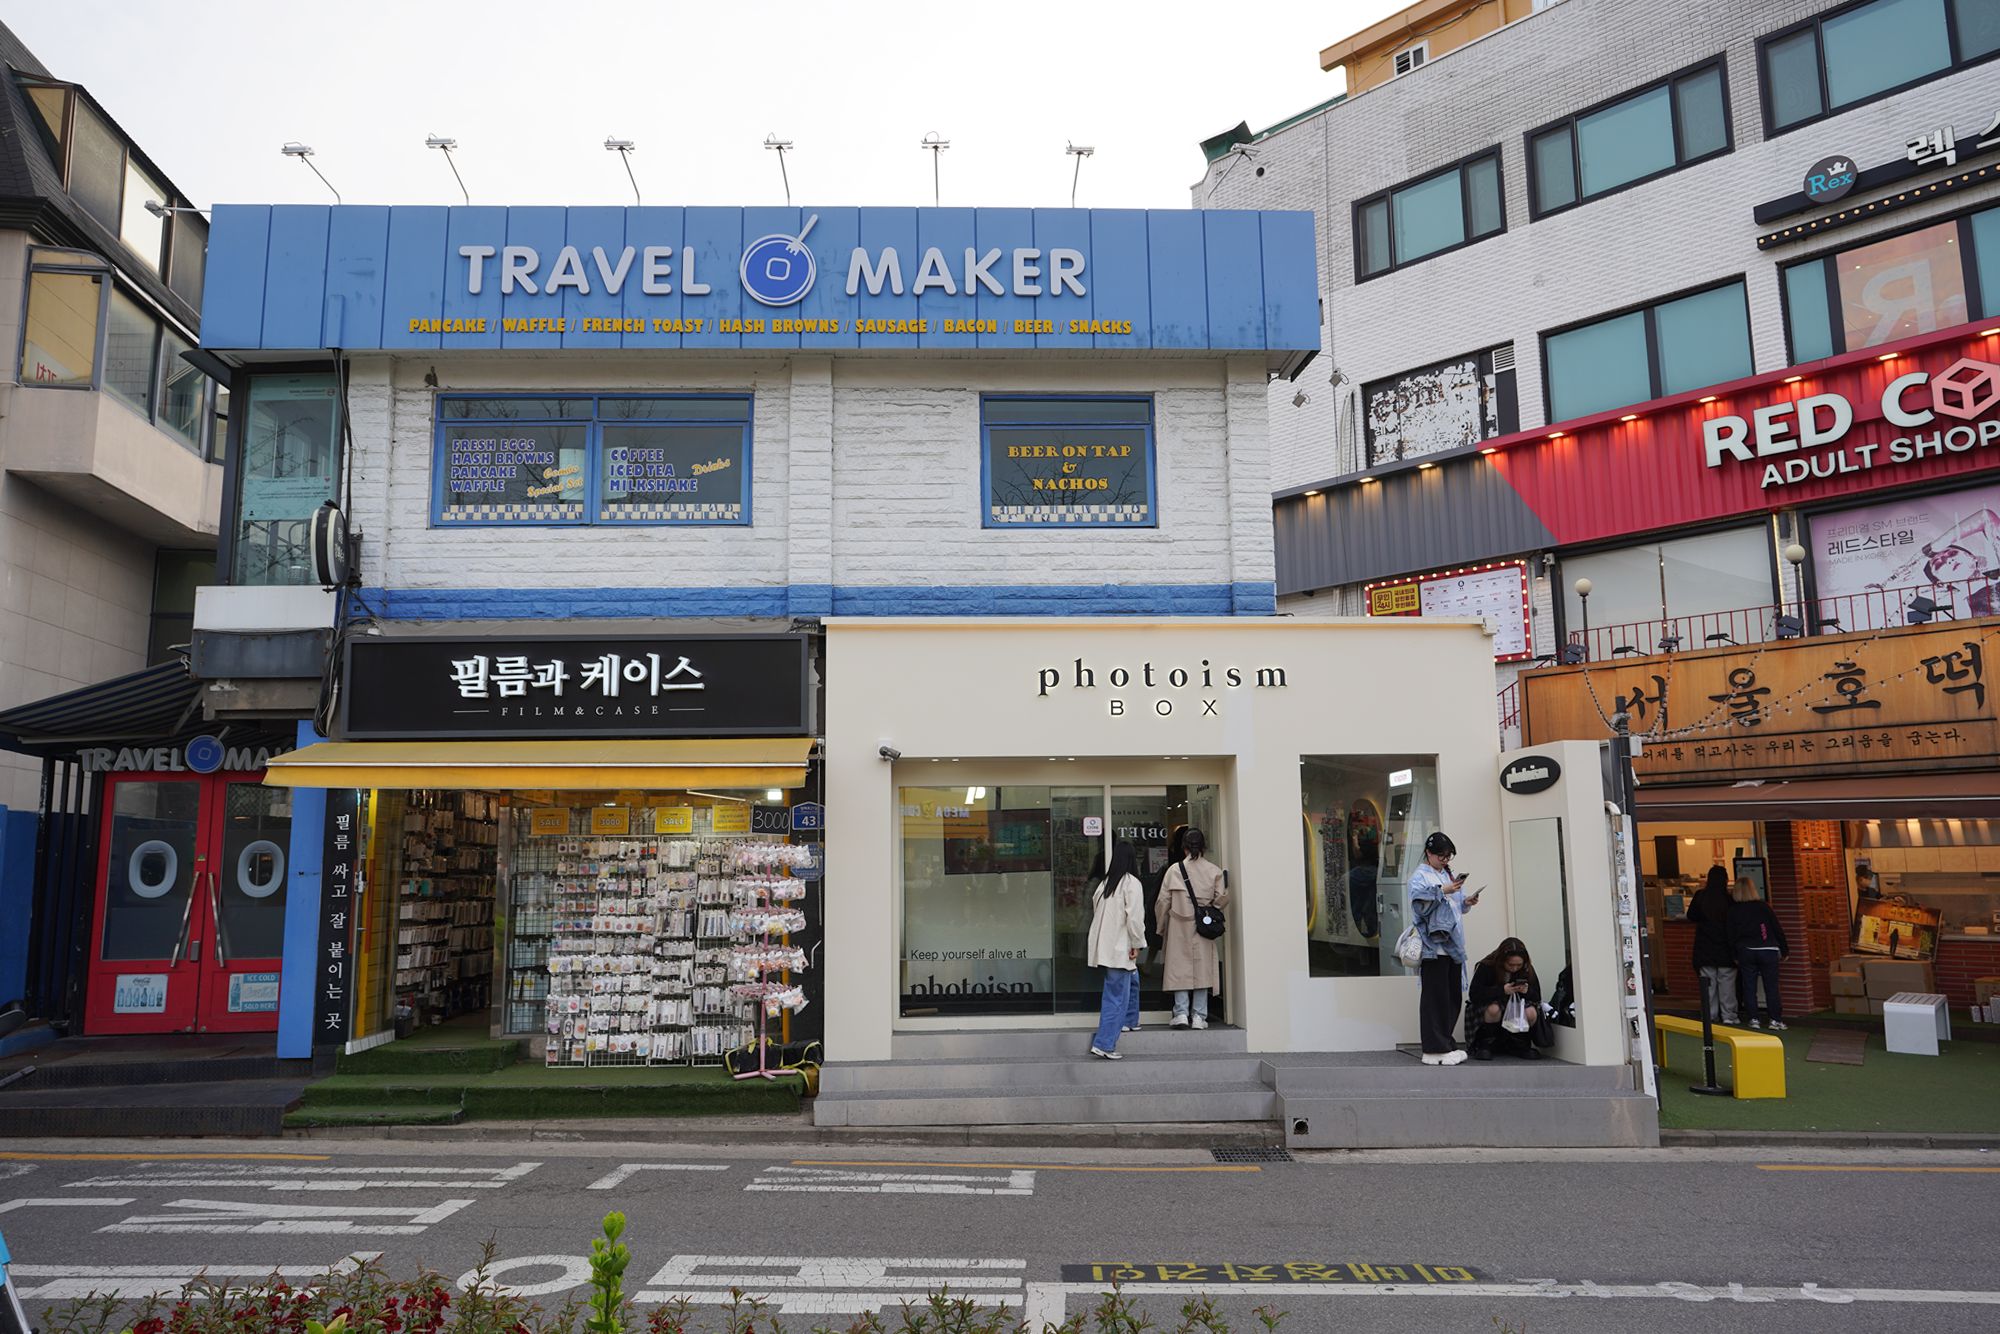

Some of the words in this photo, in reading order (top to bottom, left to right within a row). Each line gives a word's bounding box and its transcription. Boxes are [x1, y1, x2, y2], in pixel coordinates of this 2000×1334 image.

[1808, 171, 1853, 196] Rex
[459, 245, 711, 296] TRAVEL
[846, 246, 1087, 298] MAKER
[409, 319, 486, 334] PANCAKE
[502, 319, 566, 334] WAFFLE
[582, 319, 645, 334] FRENCH
[652, 319, 703, 334] TOAST
[719, 319, 765, 334] HASH
[772, 319, 839, 334] BROWNS
[855, 319, 928, 334] SAUSAGE
[944, 319, 997, 334] BACON
[1014, 319, 1053, 334] BEER
[1069, 319, 1131, 334] SNACKS
[1702, 392, 1853, 468] RED
[453, 439, 495, 451] FRESH
[501, 439, 535, 451] EGGS
[1008, 445, 1059, 458] BEER
[1062, 445, 1088, 458] ON
[1091, 445, 1131, 458] TAP
[452, 452, 490, 464] HASH
[496, 452, 554, 464] BROWNS
[610, 449, 664, 461] COFFEE
[1760, 444, 1879, 489] ADULT
[1889, 419, 2000, 463] SHOP
[451, 466, 516, 478] PANCAKE
[610, 464, 643, 477] ICED
[647, 464, 675, 477] TEA
[691, 458, 731, 476] Drinks
[1062, 461, 1077, 473] &
[450, 480, 505, 492] WAFFLE
[609, 479, 698, 492] MILKSHAKE
[1032, 478, 1108, 490] NACHOS
[1827, 523, 1870, 539] 프리미엄
[1873, 519, 1892, 531] SM
[1895, 513, 1931, 527] 브랜드
[1828, 529, 1915, 556] 레드스타일
[1828, 556, 1854, 566] MADE
[450, 654, 571, 698] 필름과
[579, 652, 705, 697] 케이스
[1038, 657, 1288, 697] photoism
[1110, 699, 1218, 716] BOX
[1765, 738, 1816, 754] 우리는
[1825, 732, 1893, 750] 그리움을
[76, 747, 185, 772] TRAVEL
[663, 816, 685, 826] SALE
[753, 810, 790, 829] 3000
[801, 815, 817, 826] 43
[334, 814, 350, 850] 필름
[331, 863, 349, 898] 싸고
[330, 912, 346, 929] 잘
[911, 949, 938, 961] Keep
[942, 949, 985, 962] yourself
[988, 949, 1012, 959] alive
[1017, 949, 1027, 959] at
[326, 942, 345, 999] 붙이는
[325, 1012, 342, 1030] 곳
